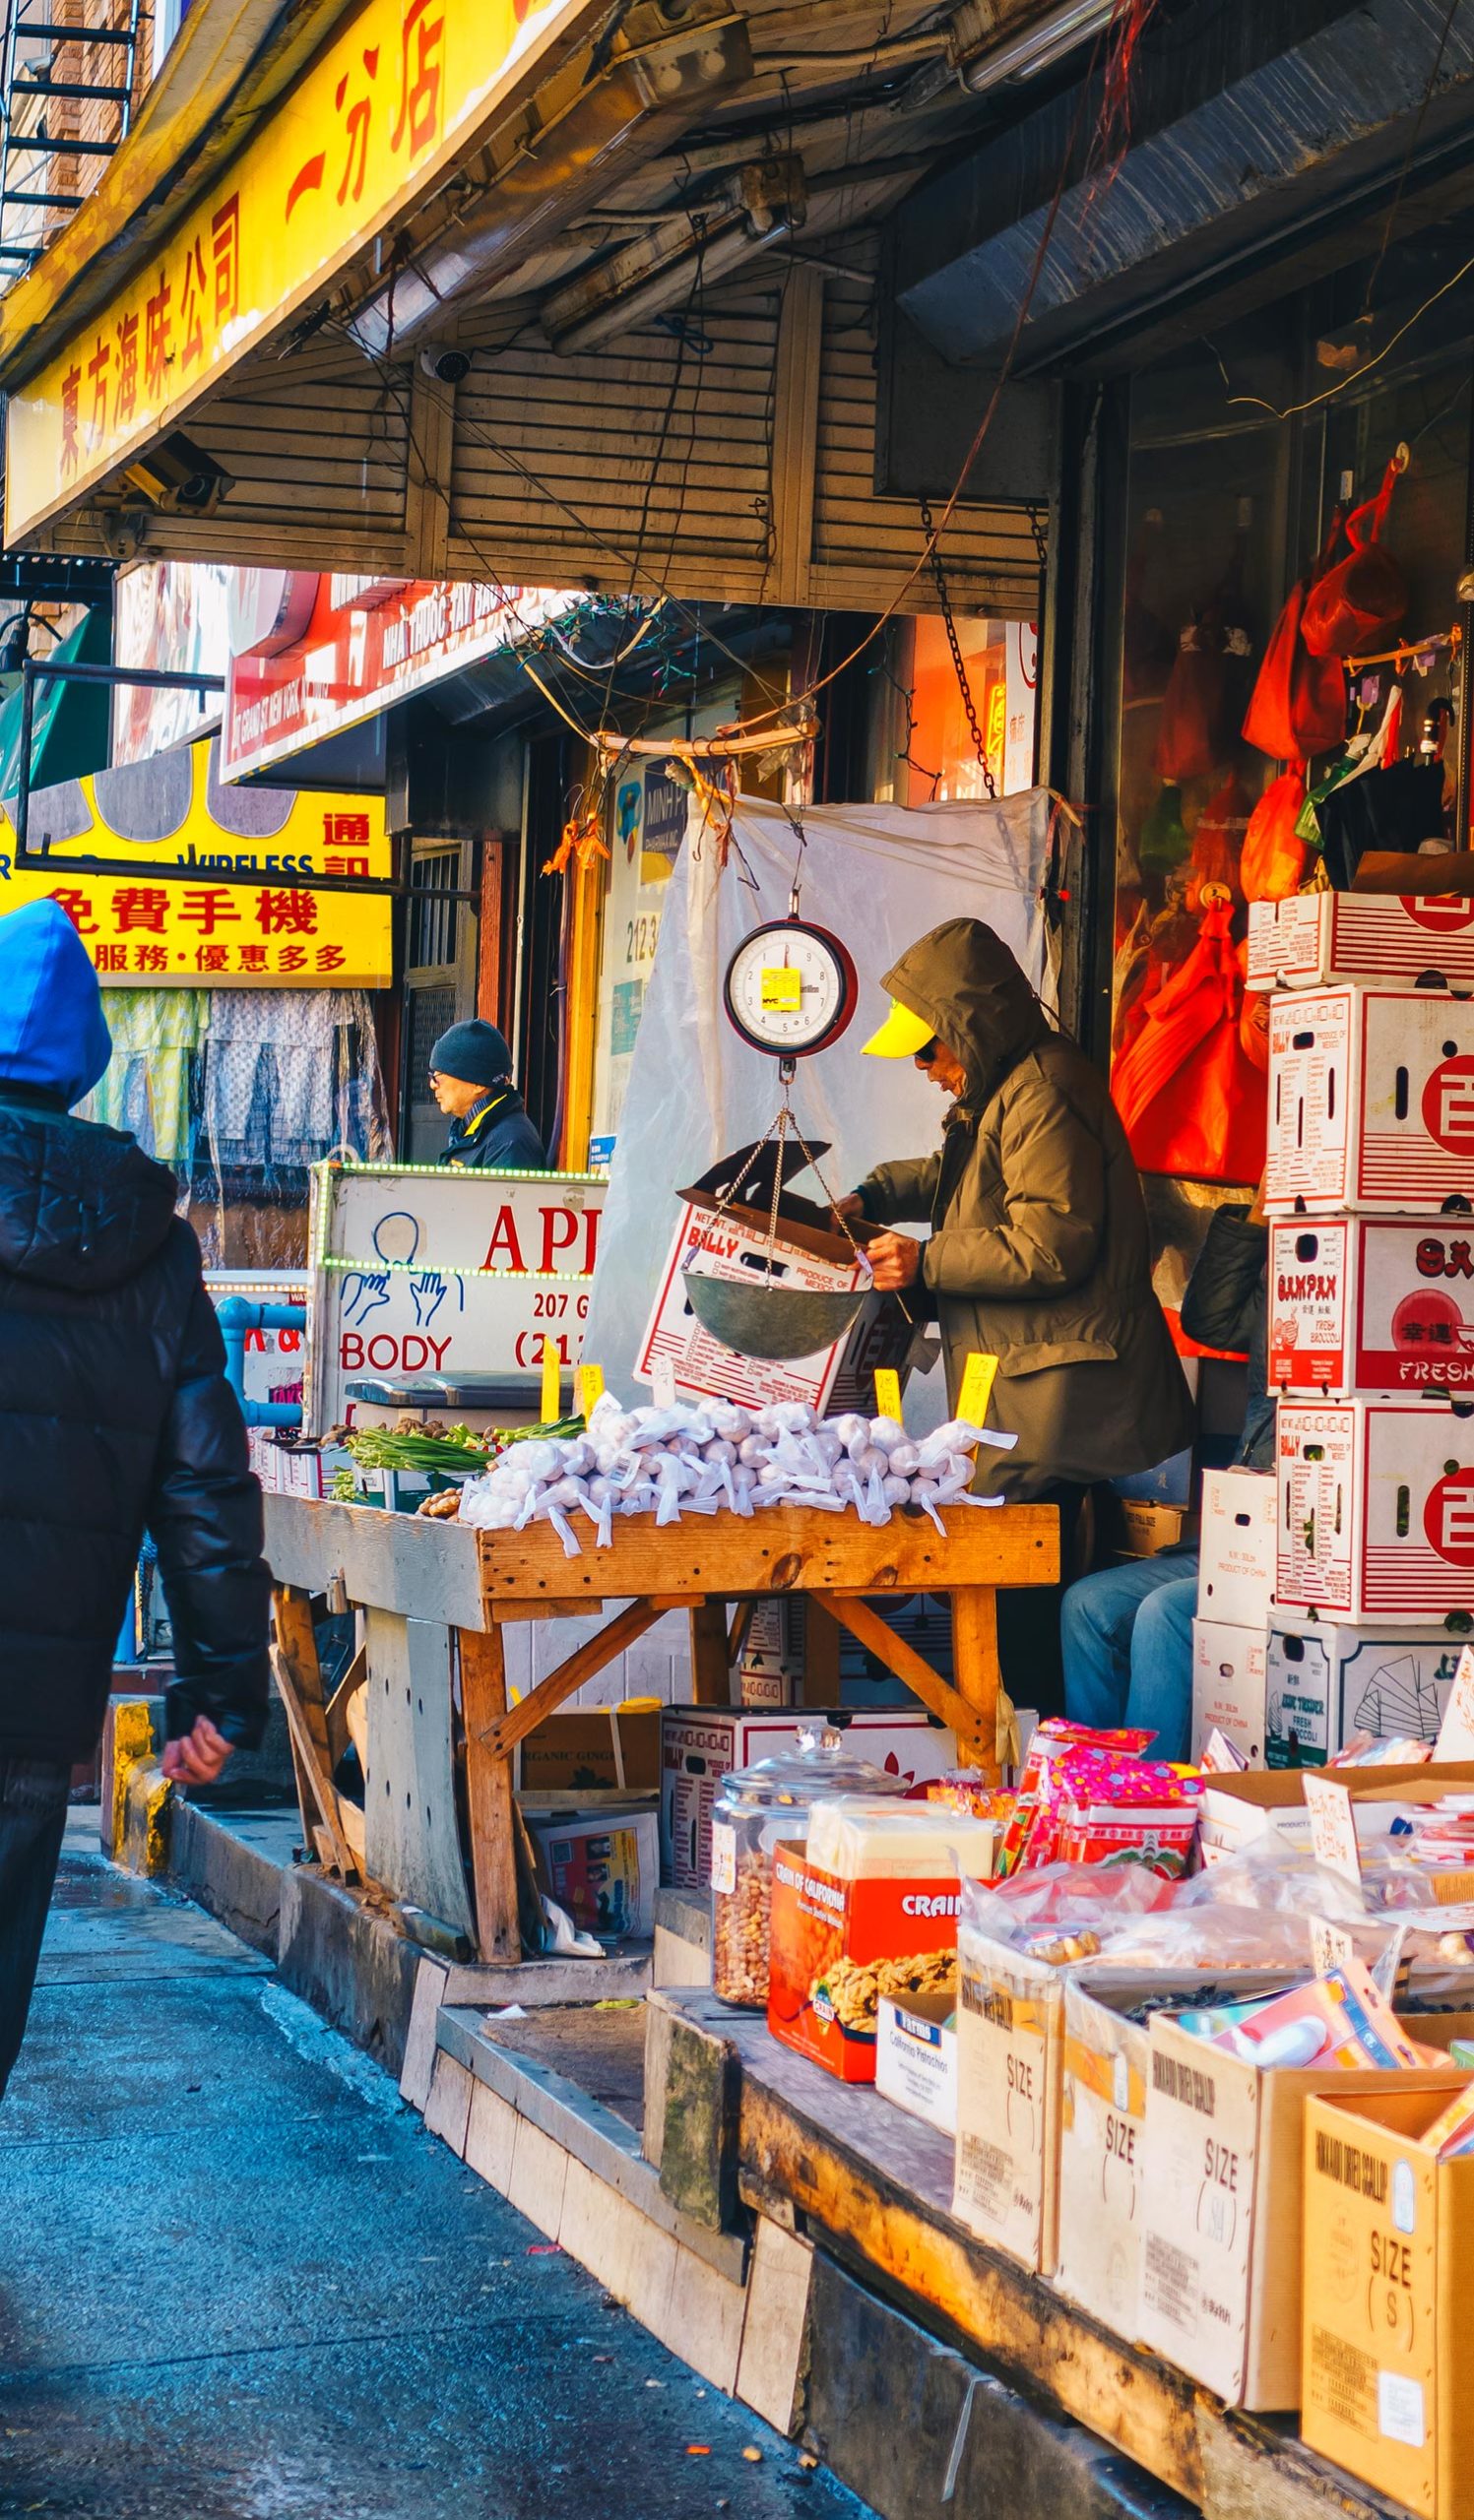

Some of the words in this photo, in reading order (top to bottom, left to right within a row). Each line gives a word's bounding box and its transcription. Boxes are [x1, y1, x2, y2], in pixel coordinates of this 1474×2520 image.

[59, 190, 241, 477] 東方海味公司
[52, 887, 318, 936] 免費手機
[687, 1226, 739, 1260] BILLY
[796, 1266, 835, 1285] PRODUCE
[836, 1281, 849, 1290] OF
[1277, 1274, 1337, 1301] SAMPAN
[534, 1292, 568, 1318] 207
[339, 1333, 452, 1371] BODY
[1402, 1322, 1452, 1345] 幸運
[1293, 1715, 1312, 1728] FRESH
[523, 1752, 574, 1762] RGANIC
[795, 1874, 804, 1893] OF
[804, 1876, 846, 1914] CALIFORNIA
[890, 2031, 917, 2058] California
[916, 2046, 948, 2074] Pistachios
[1007, 2053, 1033, 2099] SIZE
[1106, 2114, 1135, 2165] SIZE
[1204, 2138, 1239, 2193] SIZE
[1371, 2230, 1411, 2290] SIZE
